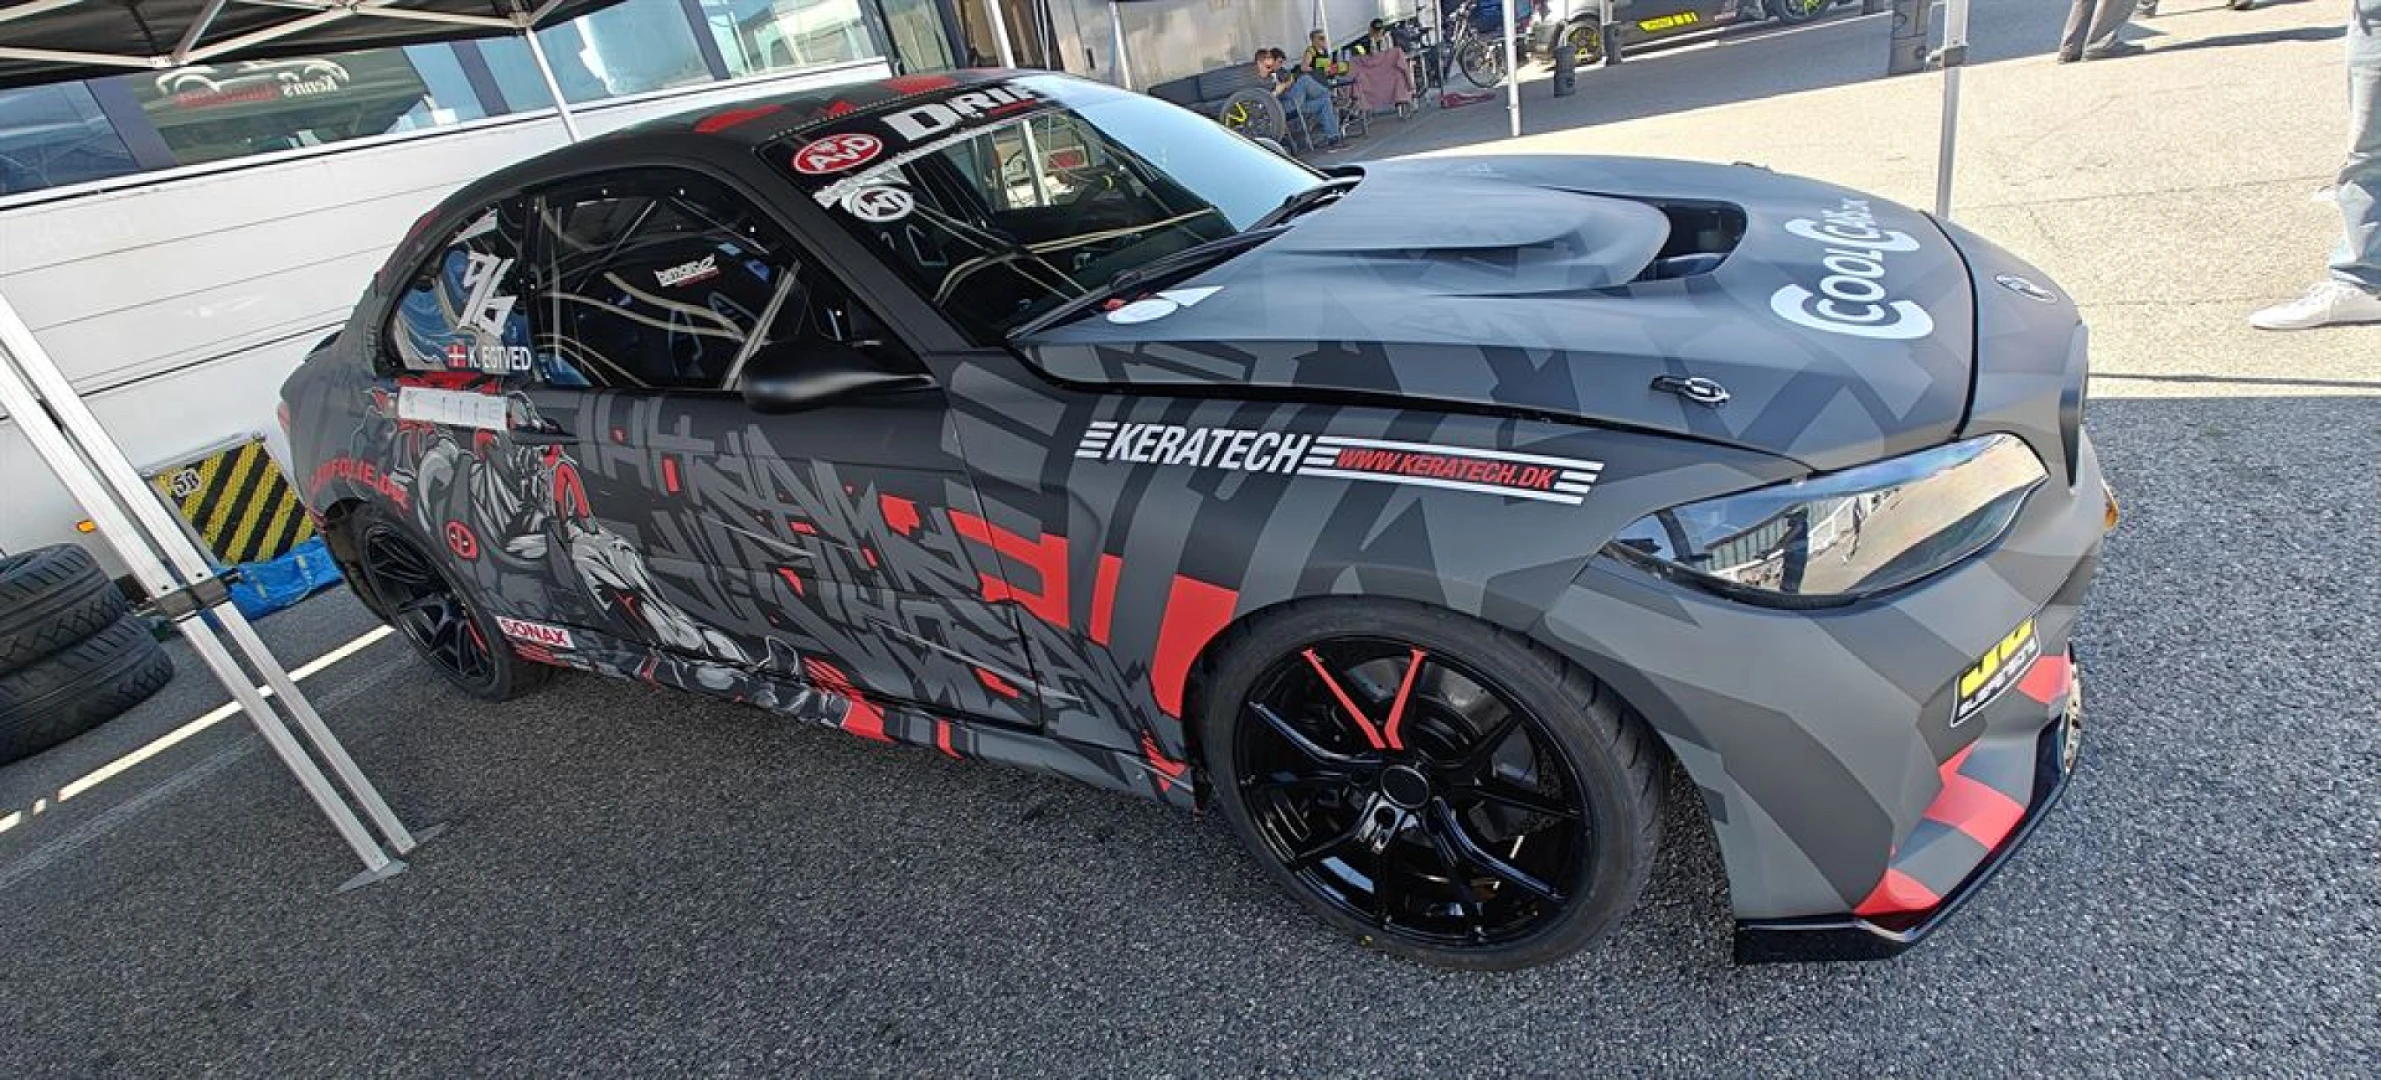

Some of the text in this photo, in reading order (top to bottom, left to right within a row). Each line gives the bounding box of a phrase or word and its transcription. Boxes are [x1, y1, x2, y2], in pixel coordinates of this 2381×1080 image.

[482, 346, 532, 371] EGTVED
[1106, 423, 1310, 474] KERATECH
[500, 619, 569, 646] SONAX
